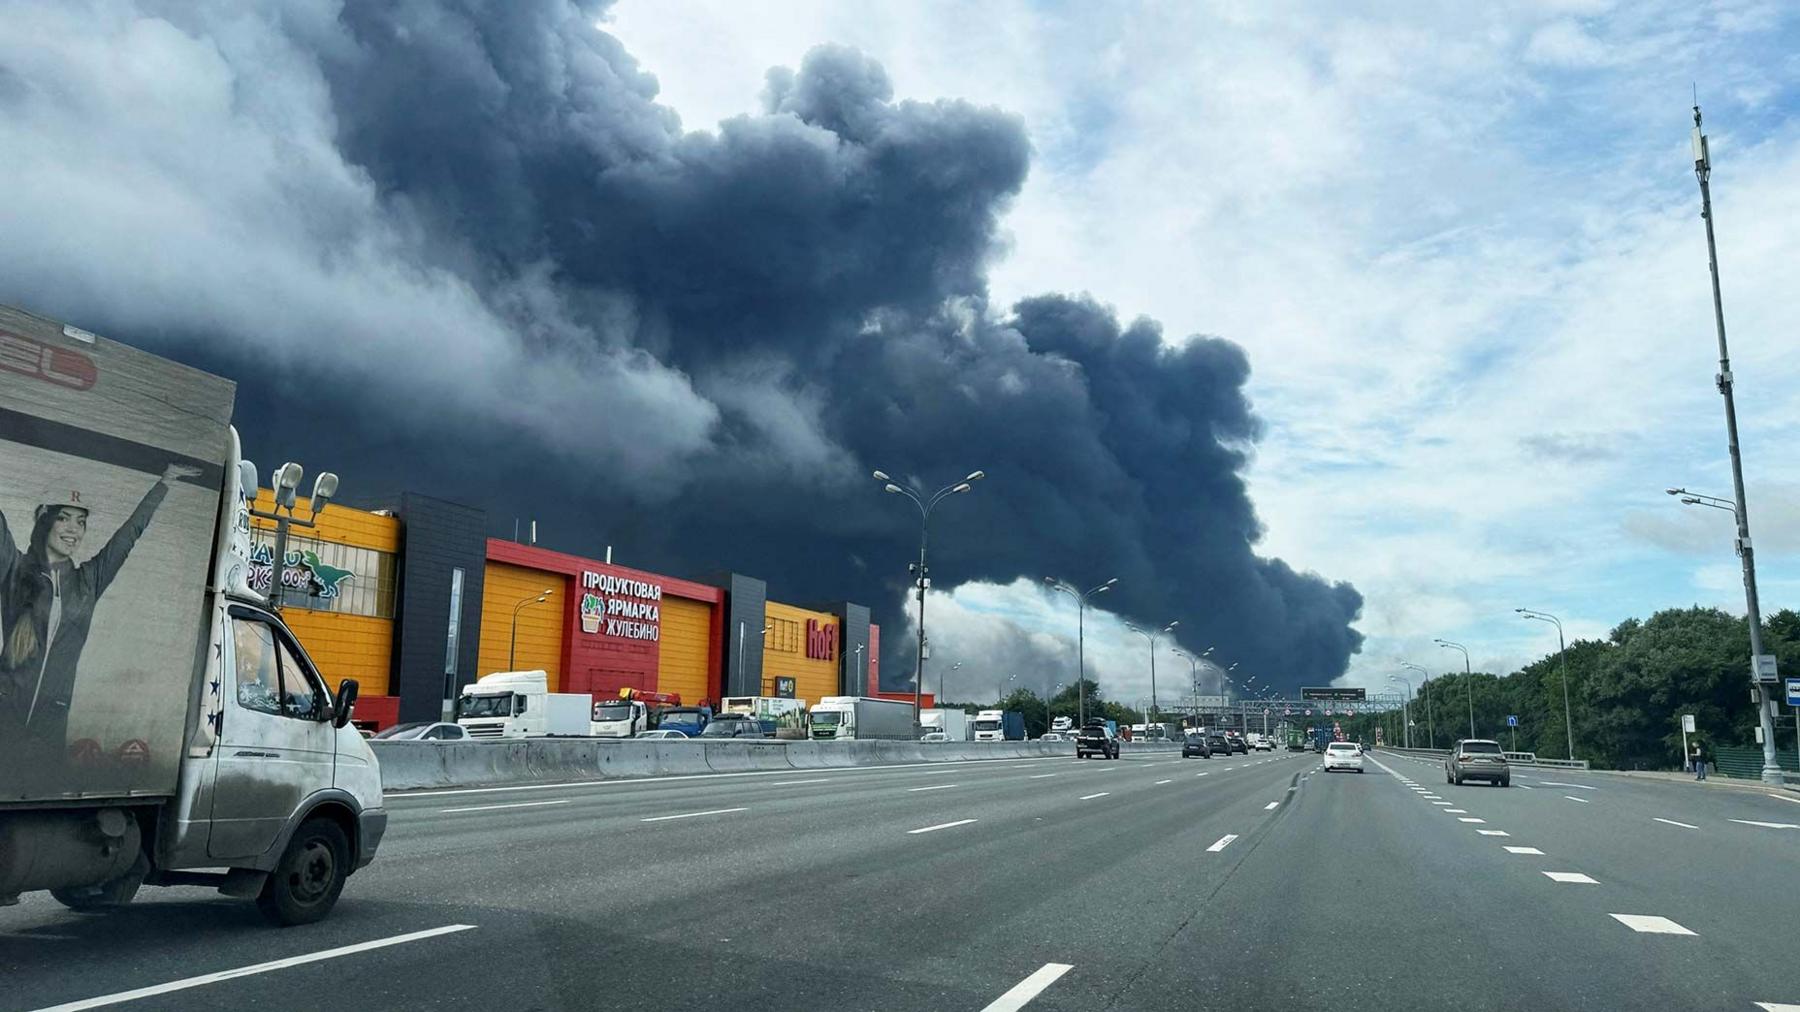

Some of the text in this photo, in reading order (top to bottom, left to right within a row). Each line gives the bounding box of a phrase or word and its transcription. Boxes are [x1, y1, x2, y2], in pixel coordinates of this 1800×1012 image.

[583, 570, 661, 601] ПРОДУКТОВАЯ
[607, 599, 659, 622] ЯРМАРКА
[606, 618, 659, 641] ЖУЛЕБИНО
